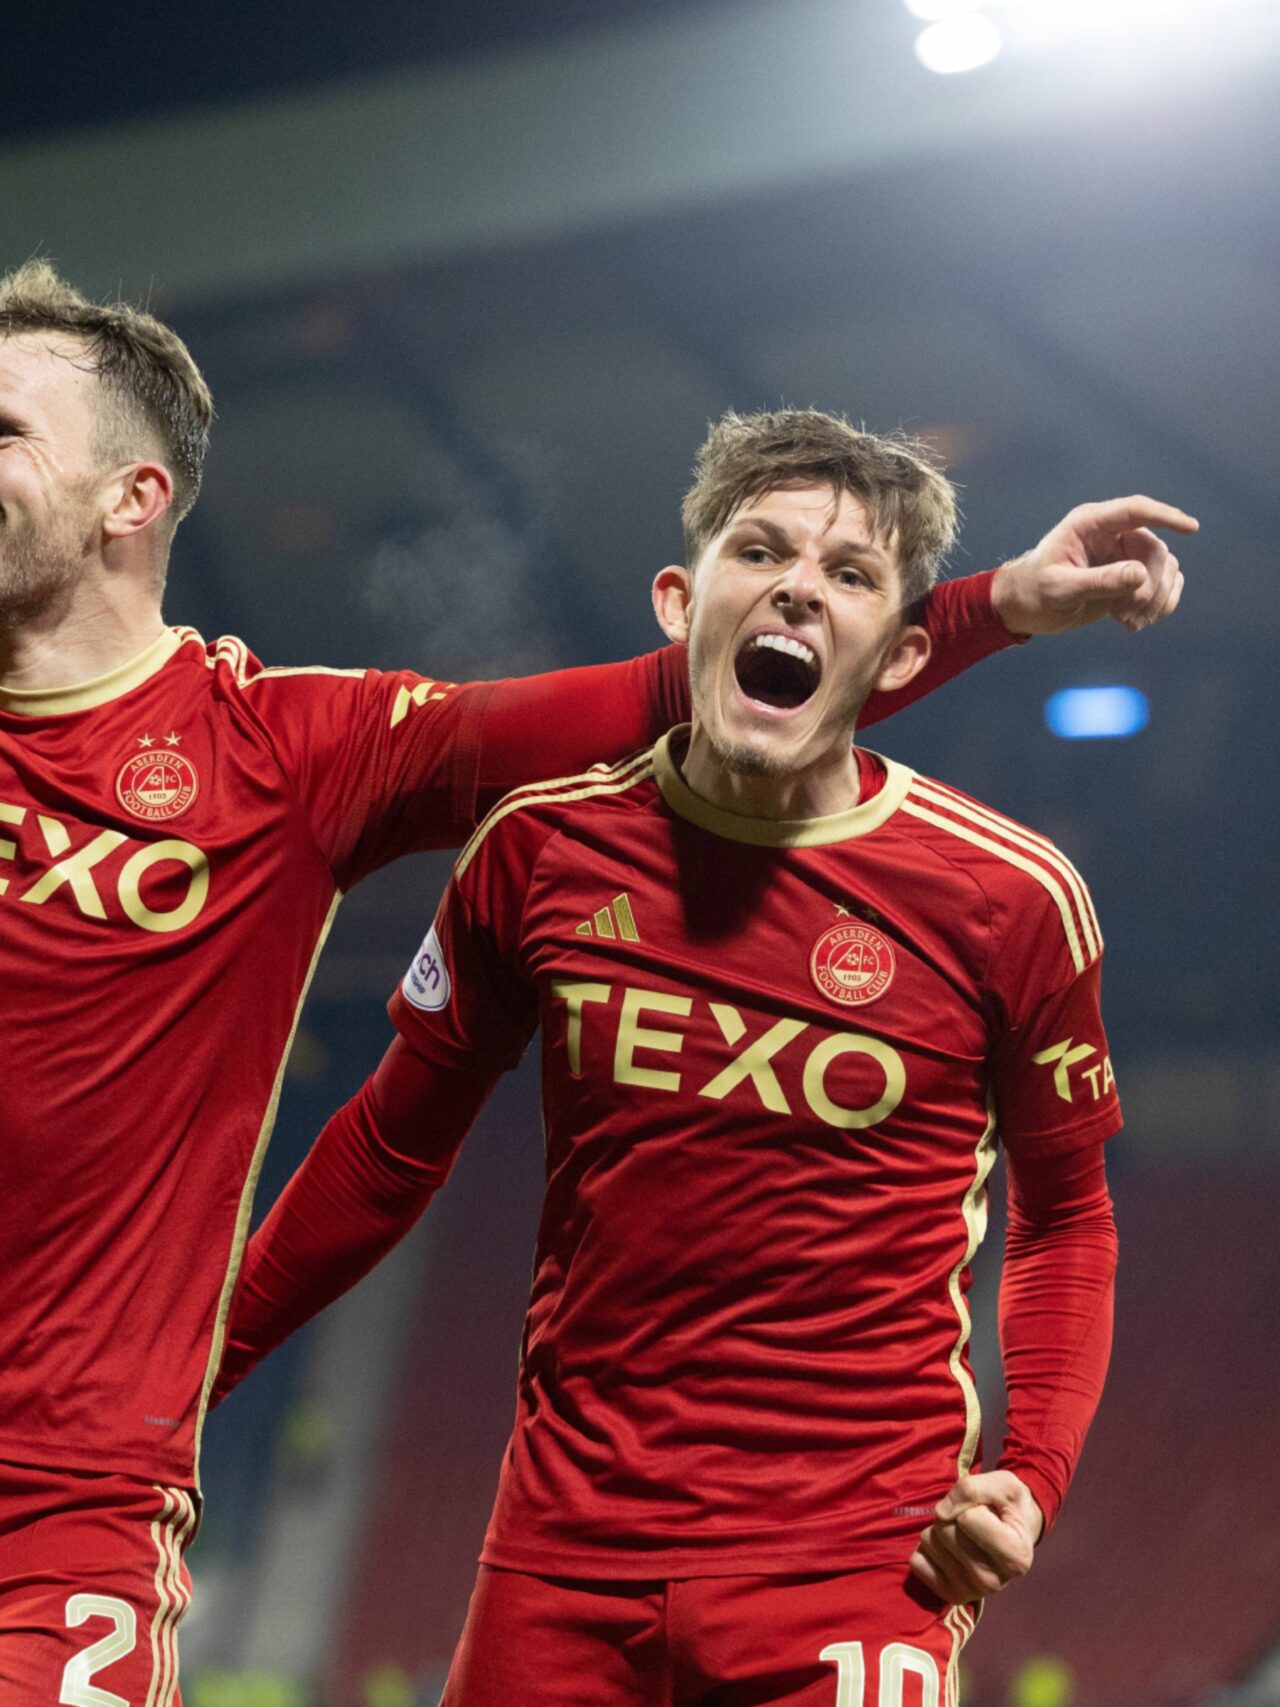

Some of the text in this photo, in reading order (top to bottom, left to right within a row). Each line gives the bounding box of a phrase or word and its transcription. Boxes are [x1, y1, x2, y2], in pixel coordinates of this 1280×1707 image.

[130, 754, 183, 772] ABERDEEN
[123, 786, 192, 817] FOOTBALL CLUB
[829, 929, 883, 950] ABERDEEN
[817, 965, 888, 1000] FOOTBALL CLUB
[843, 974, 861, 982] 1903
[551, 979, 906, 1128] TEXO
[59, 1593, 137, 1707] 2
[819, 1640, 939, 1707] 10
